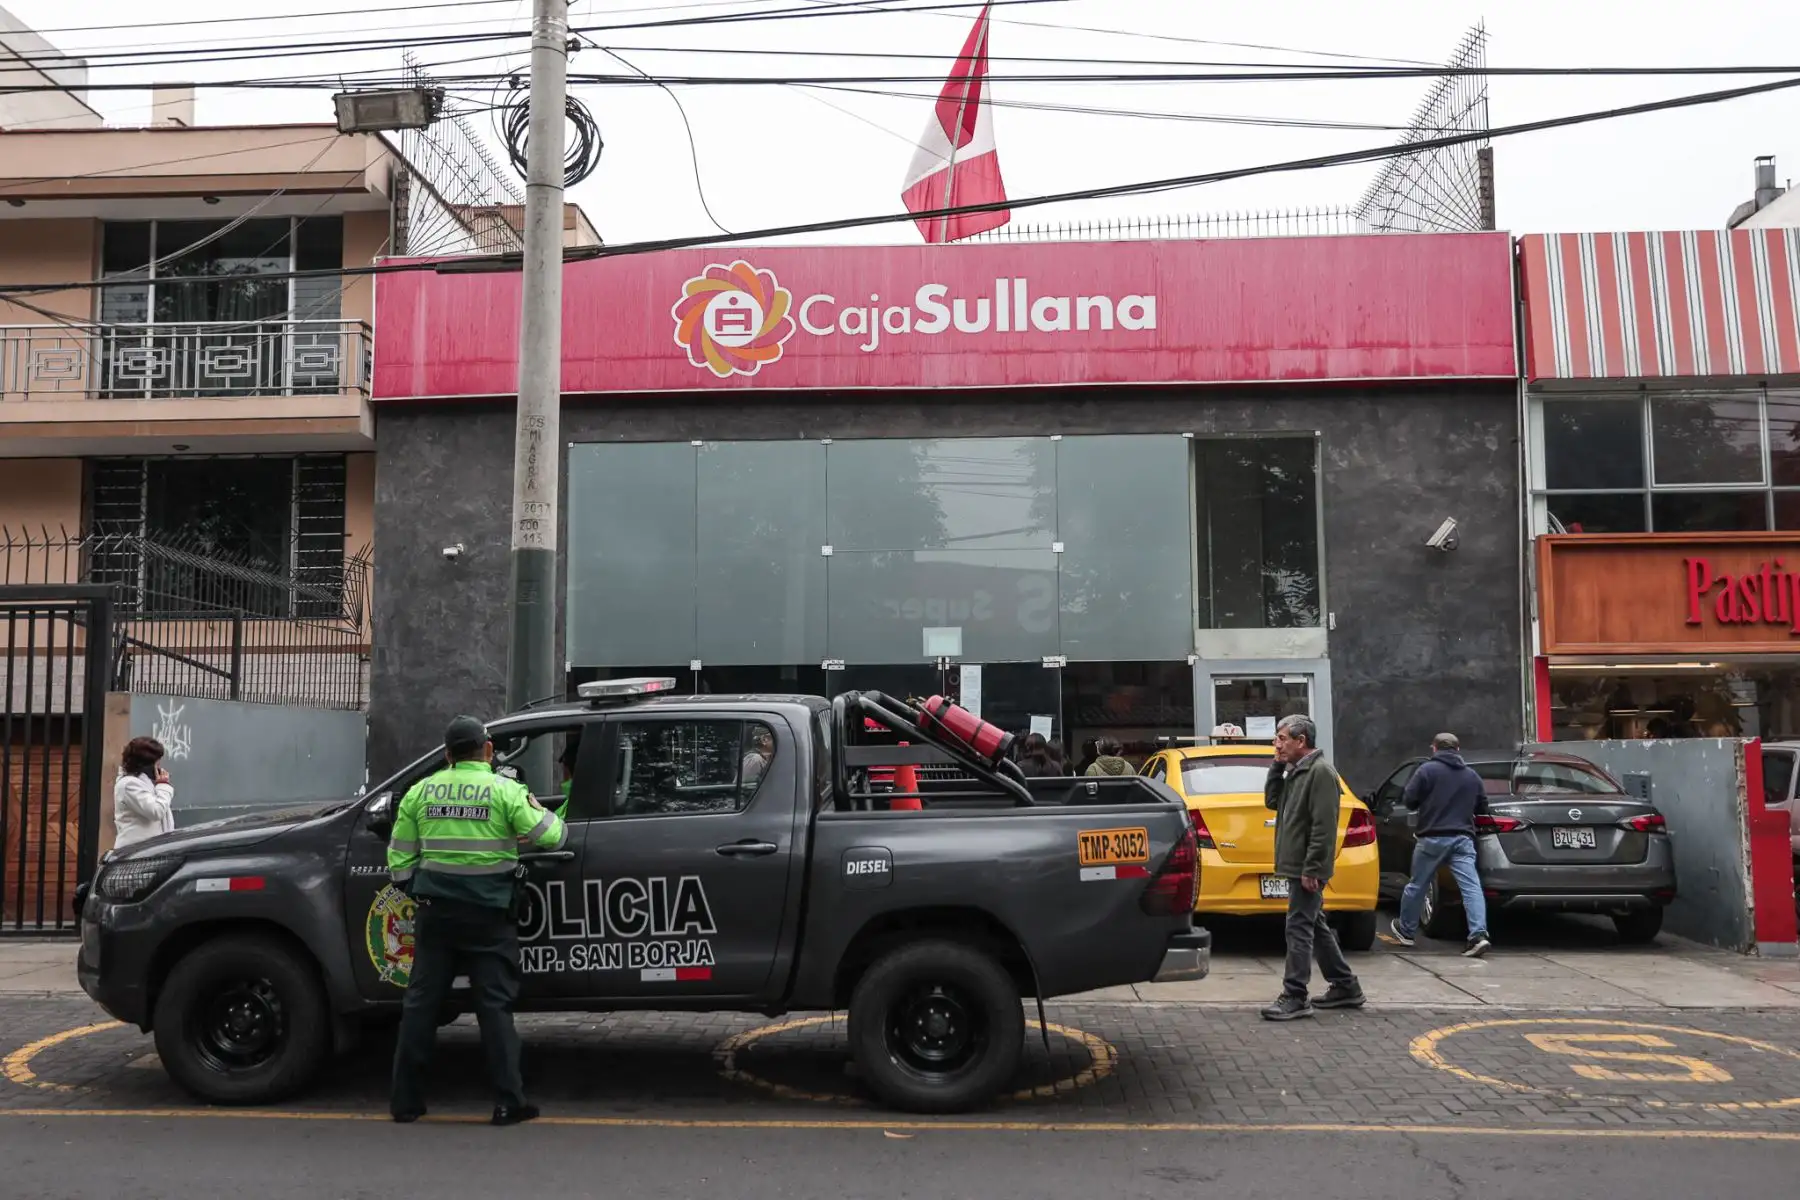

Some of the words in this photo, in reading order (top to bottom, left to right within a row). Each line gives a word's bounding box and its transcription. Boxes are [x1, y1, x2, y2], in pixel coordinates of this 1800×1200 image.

[424, 783, 492, 802] POLICIA
[446, 806, 461, 817] SAN
[463, 807, 487, 818] BORJA
[1081, 833, 1145, 860] TMP-3052
[1555, 832, 1595, 845] BZU-431
[846, 860, 889, 875] DIESEL
[517, 876, 718, 942] OLICIA
[519, 946, 565, 973] NP.
[570, 943, 622, 970] SAN
[628, 939, 716, 968] BORJA
